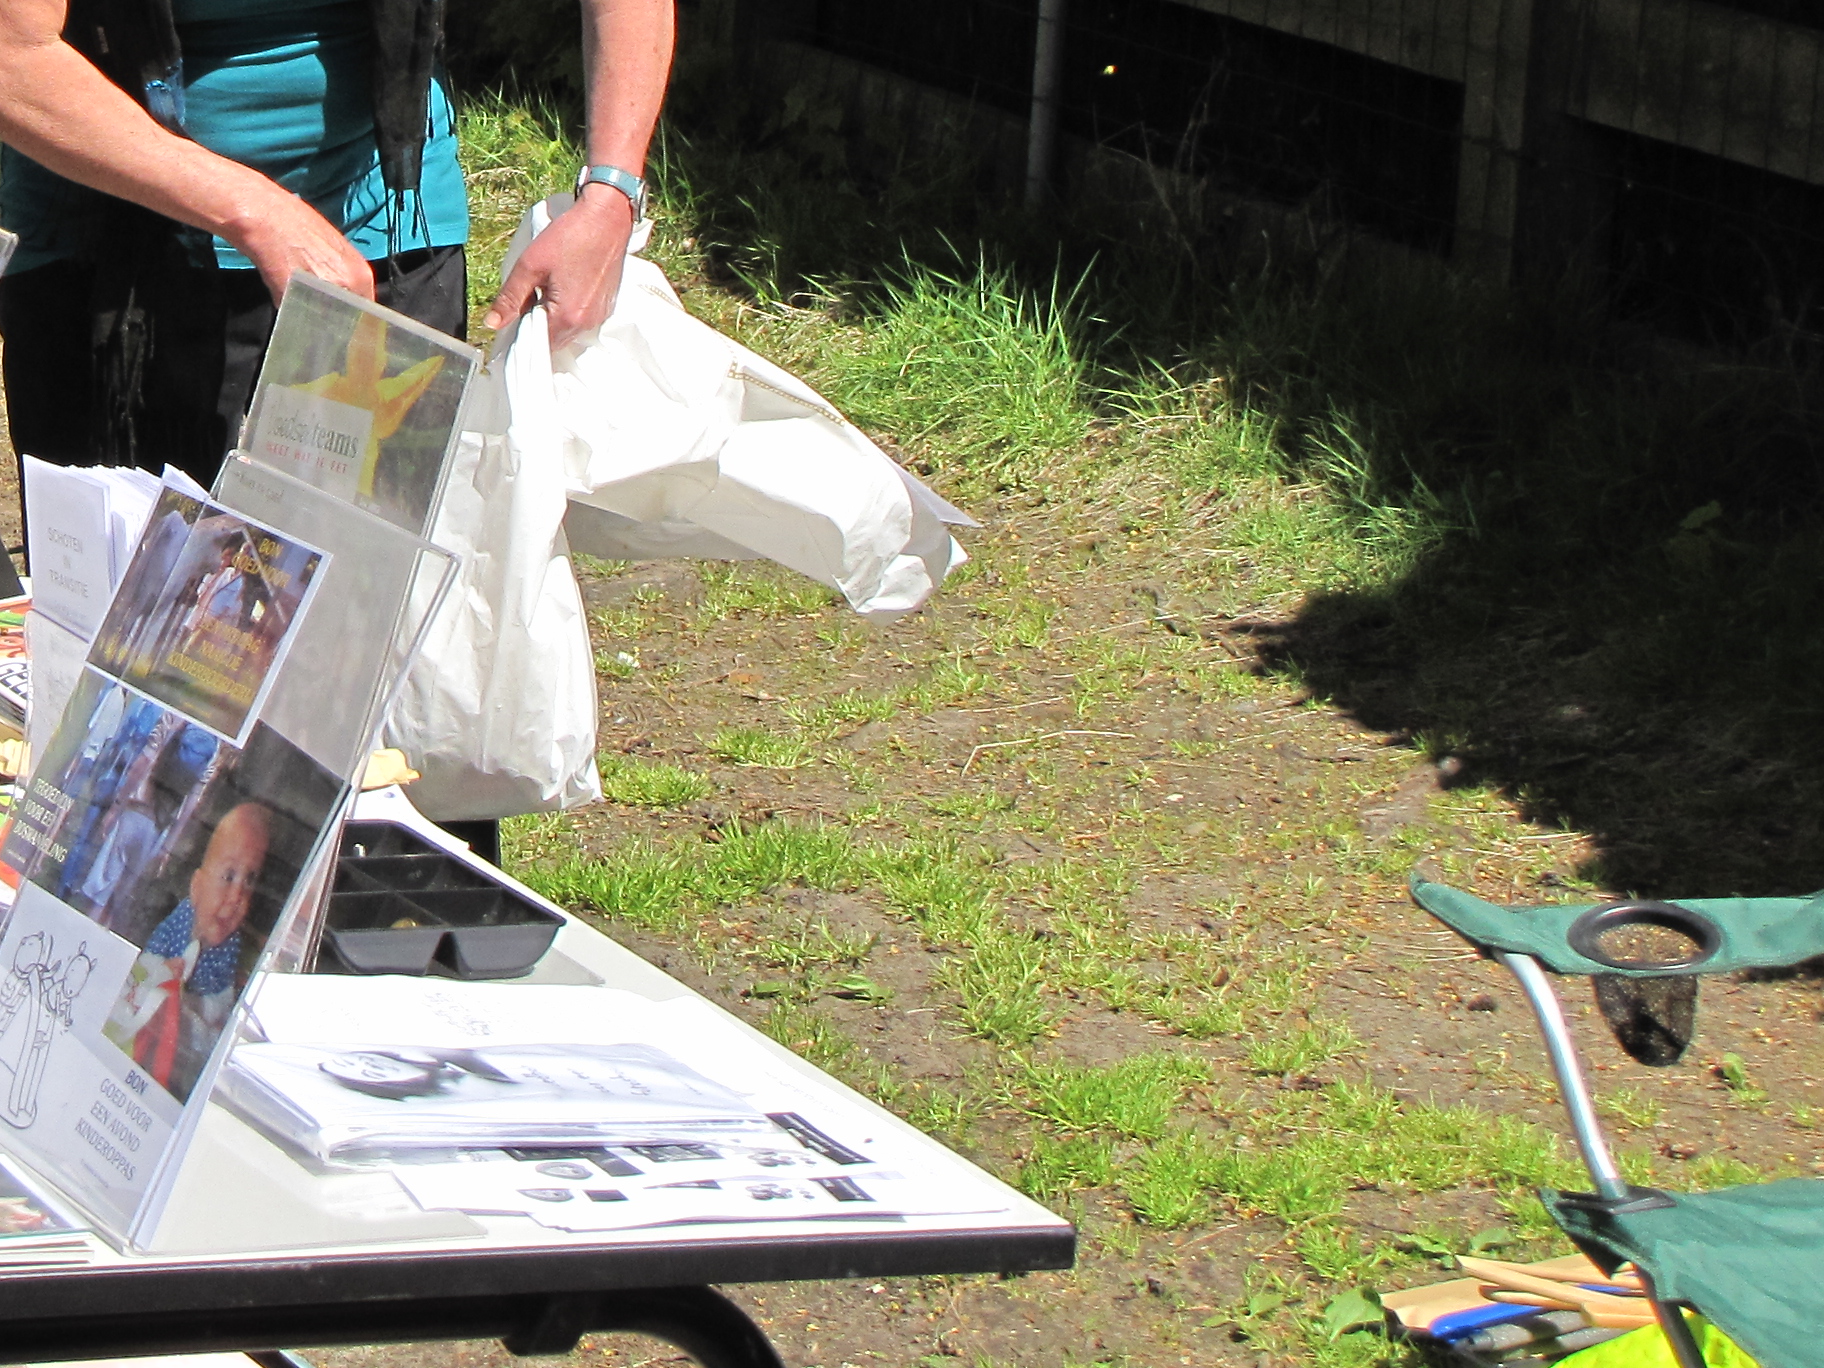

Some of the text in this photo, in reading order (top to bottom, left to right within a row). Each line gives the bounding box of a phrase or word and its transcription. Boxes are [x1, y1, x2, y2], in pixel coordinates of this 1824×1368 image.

[99, 1078, 154, 1133] GOED VOOR
[125, 1069, 148, 1095] BON
[75, 1117, 138, 1181] KINDEROPPAS
[89, 1101, 142, 1155] EEN AVOND
